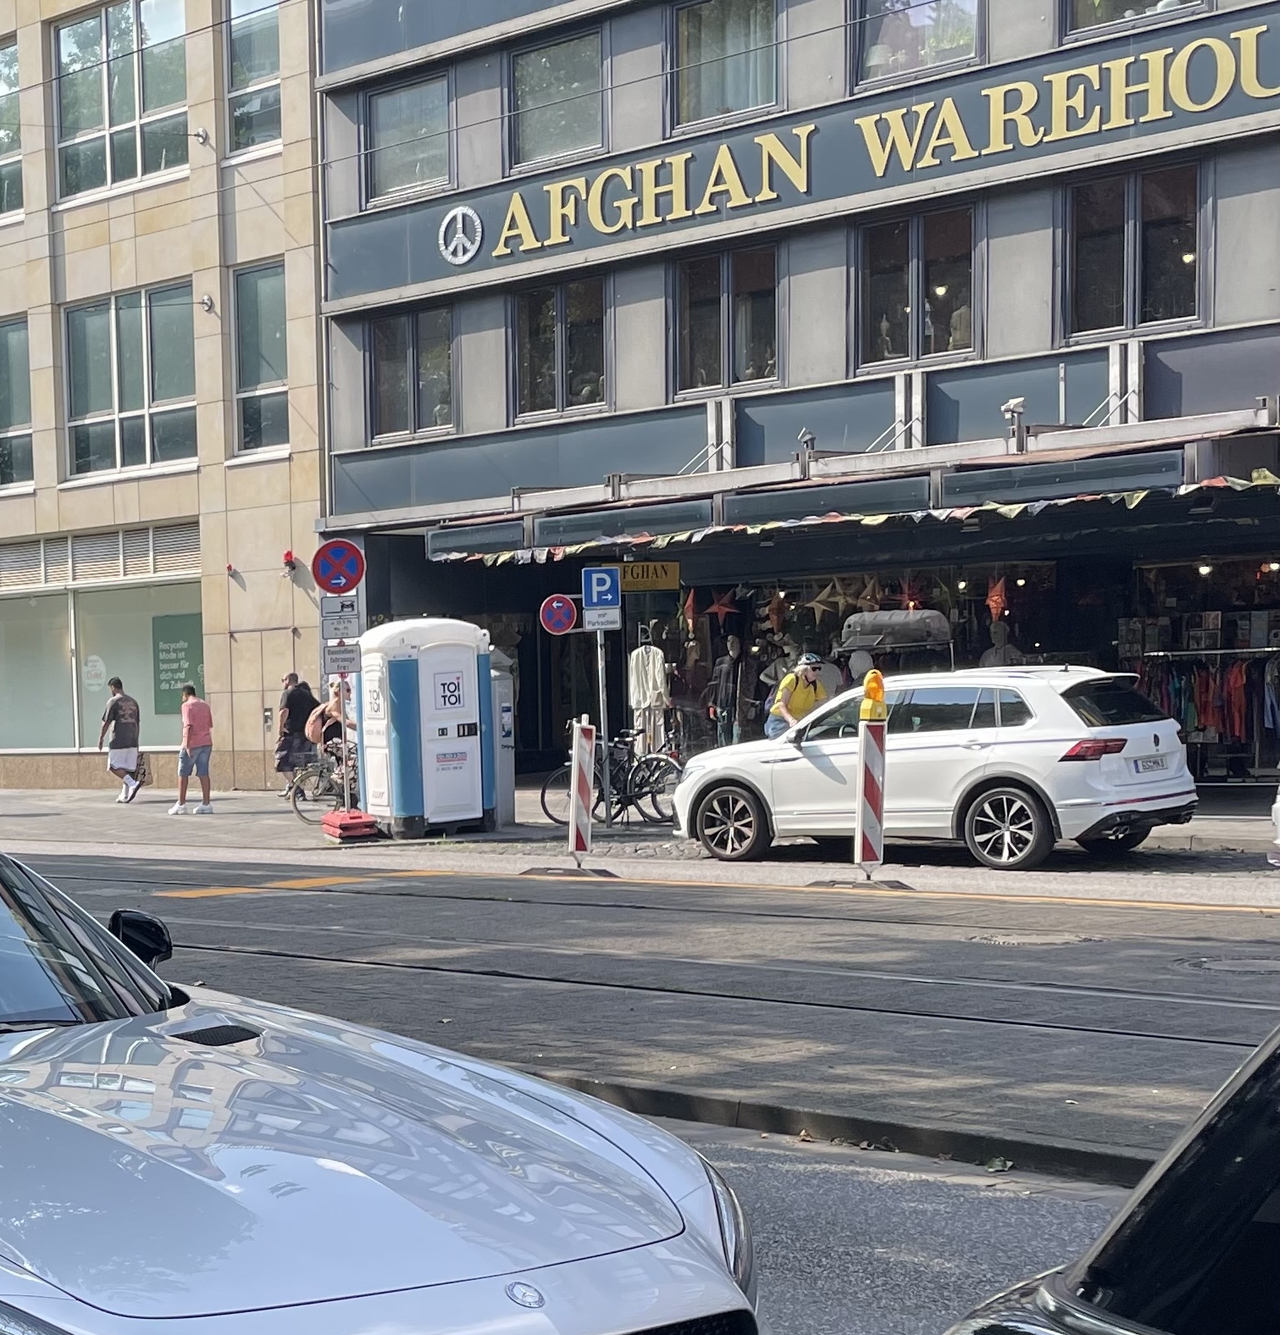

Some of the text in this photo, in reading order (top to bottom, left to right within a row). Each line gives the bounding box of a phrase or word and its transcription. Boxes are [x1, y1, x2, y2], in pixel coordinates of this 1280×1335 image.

[491, 25, 1280, 257] AFGHAN WAREHOU
[622, 564, 669, 580] FGHAN
[591, 573, 611, 603] P
[159, 650, 186, 660] Mode ist
[180, 660, 190, 669] für
[173, 670, 186, 679] und
[441, 694, 461, 706] TOI
